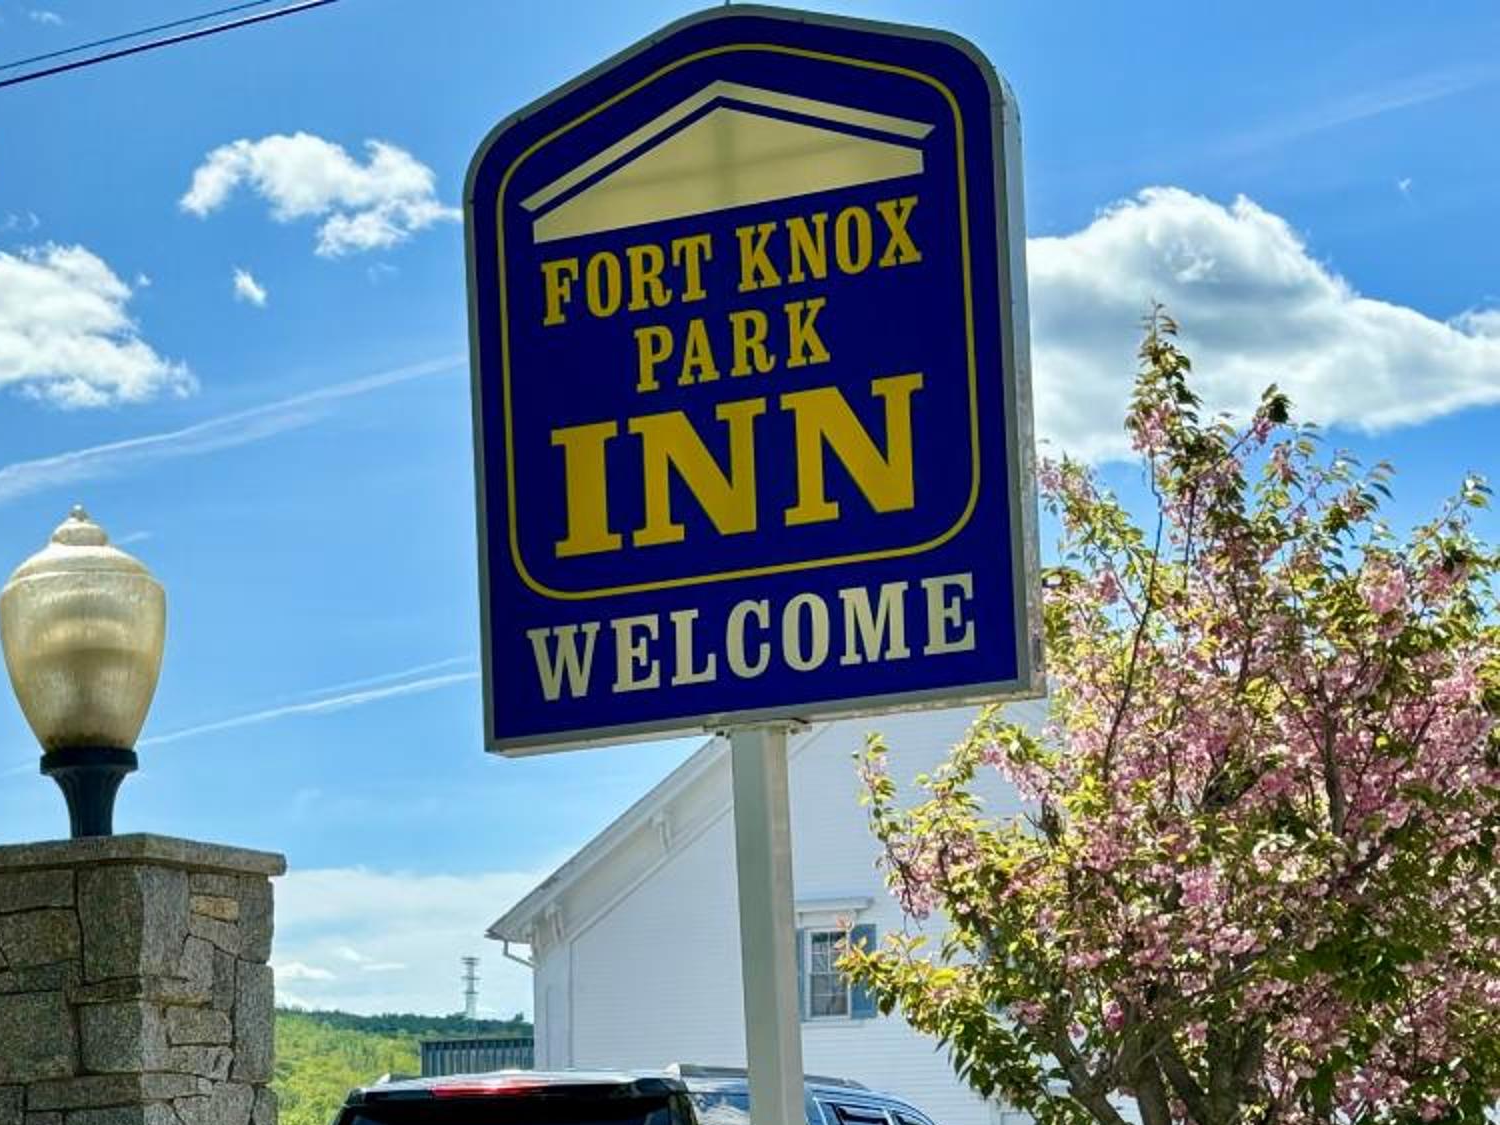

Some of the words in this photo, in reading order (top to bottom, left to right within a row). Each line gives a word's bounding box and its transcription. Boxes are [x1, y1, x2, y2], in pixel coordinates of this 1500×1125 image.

[540, 233, 712, 327] FORT
[735, 196, 922, 293] KNOX
[634, 297, 830, 394] PARK
[551, 372, 924, 559] INN
[526, 572, 976, 702] WELCOME
